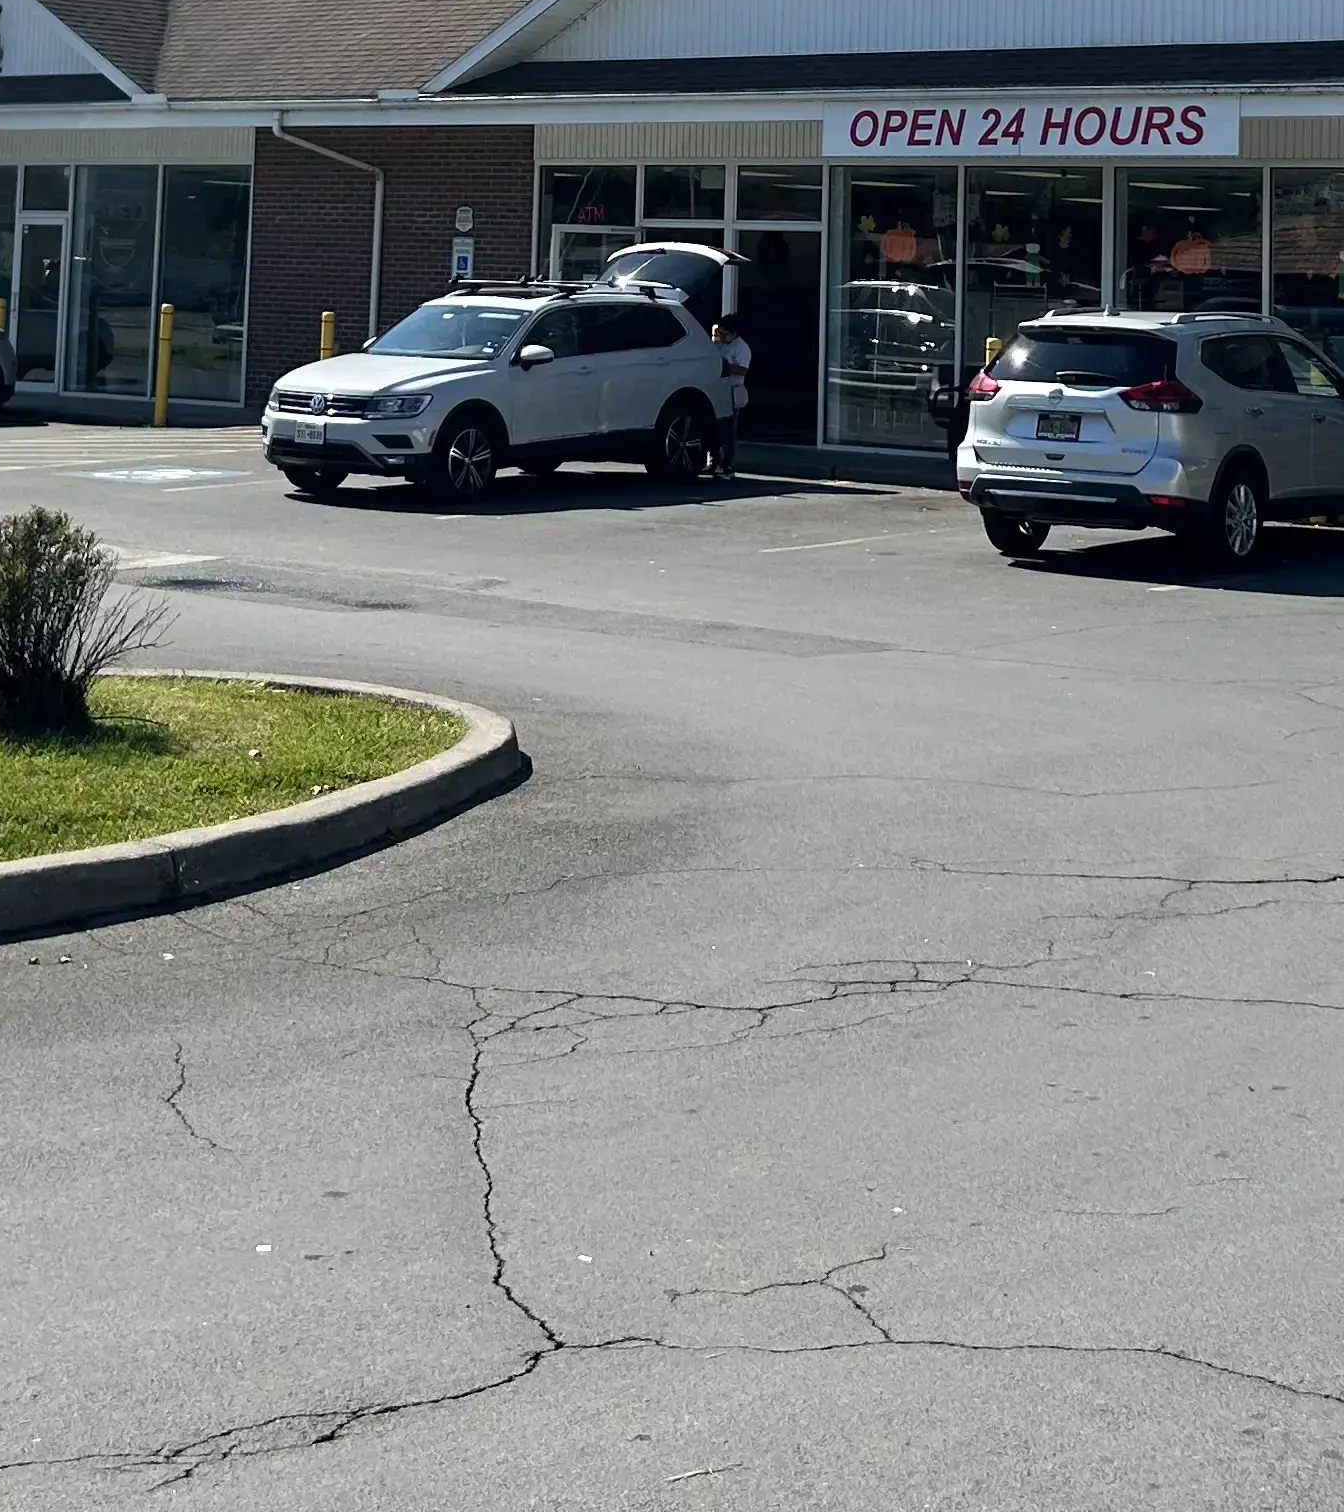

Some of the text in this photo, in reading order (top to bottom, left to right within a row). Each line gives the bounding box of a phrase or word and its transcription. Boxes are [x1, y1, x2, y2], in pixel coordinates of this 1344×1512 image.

[850, 105, 1206, 147] OPEN 24 HOURS
[578, 206, 605, 221] ATM
